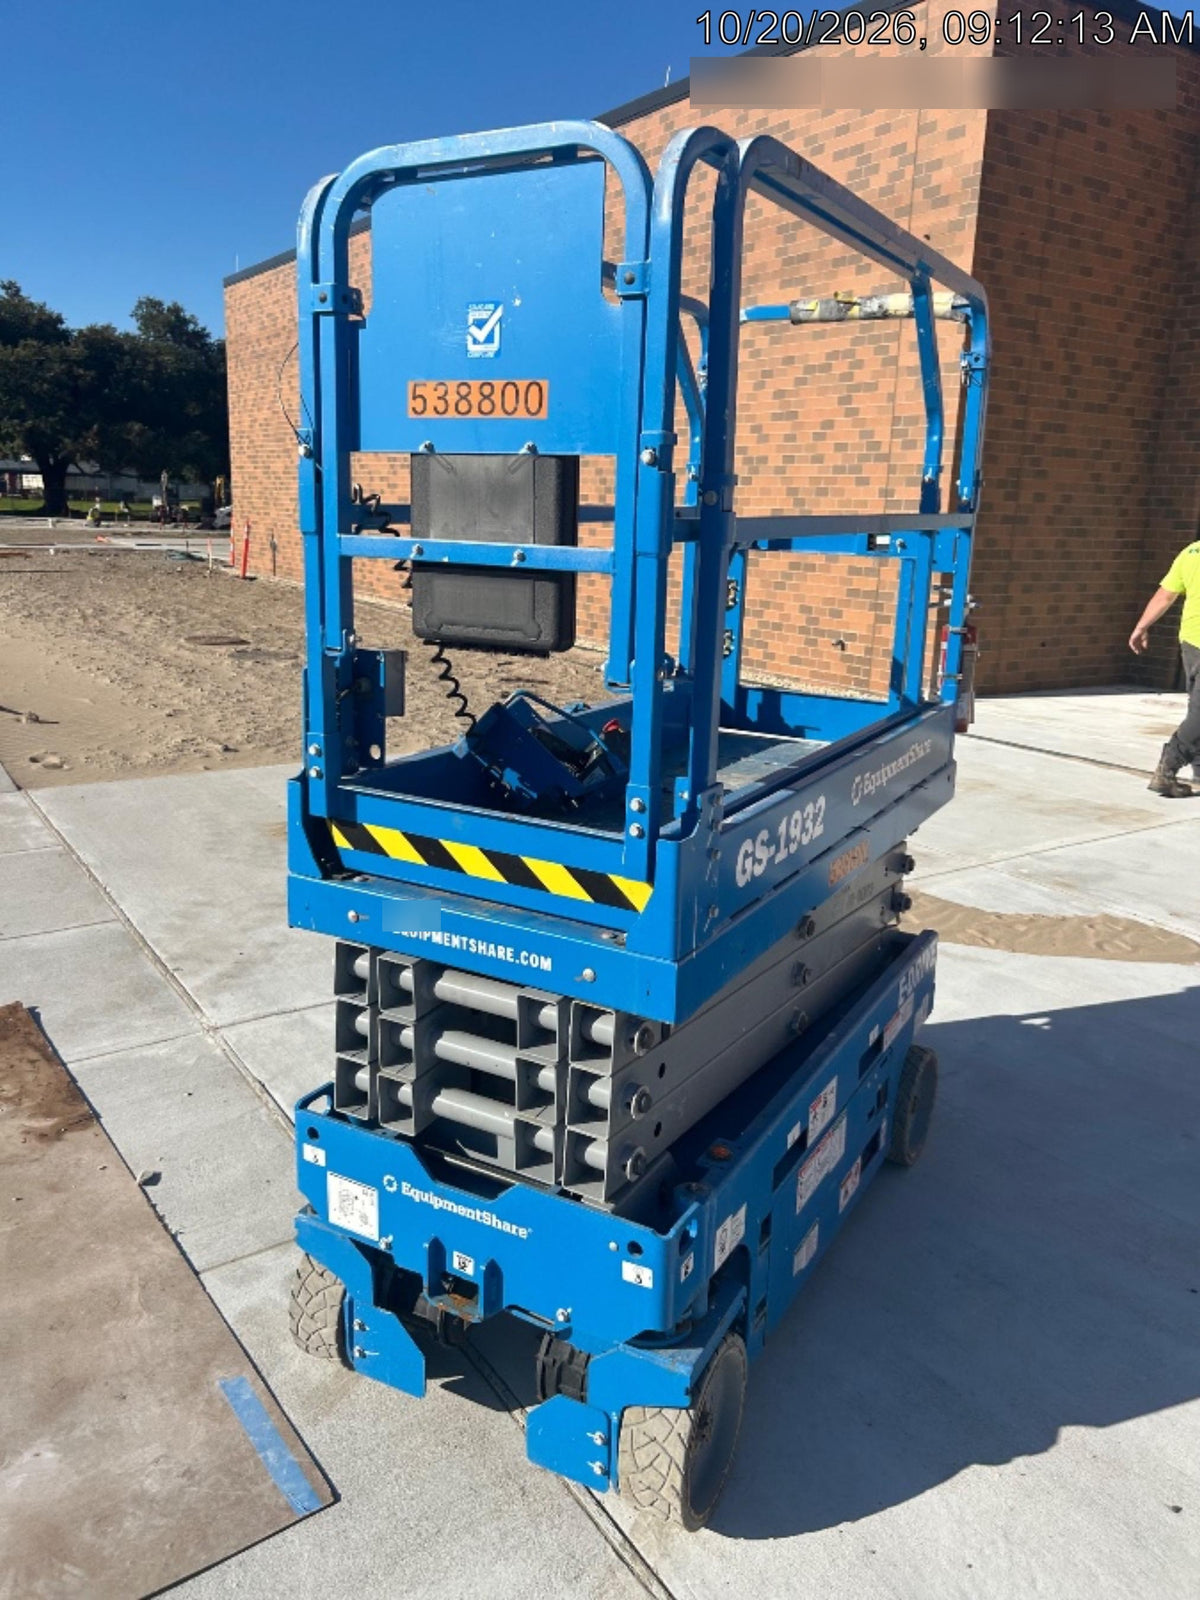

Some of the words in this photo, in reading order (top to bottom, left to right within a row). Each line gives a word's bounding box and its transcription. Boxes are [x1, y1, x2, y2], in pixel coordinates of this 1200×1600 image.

[411, 381, 543, 416] 538800
[735, 794, 826, 888] GS-1932
[393, 931, 553, 972] UIPMENTSHARE.COM
[401, 1181, 528, 1239] EquipmentShare
